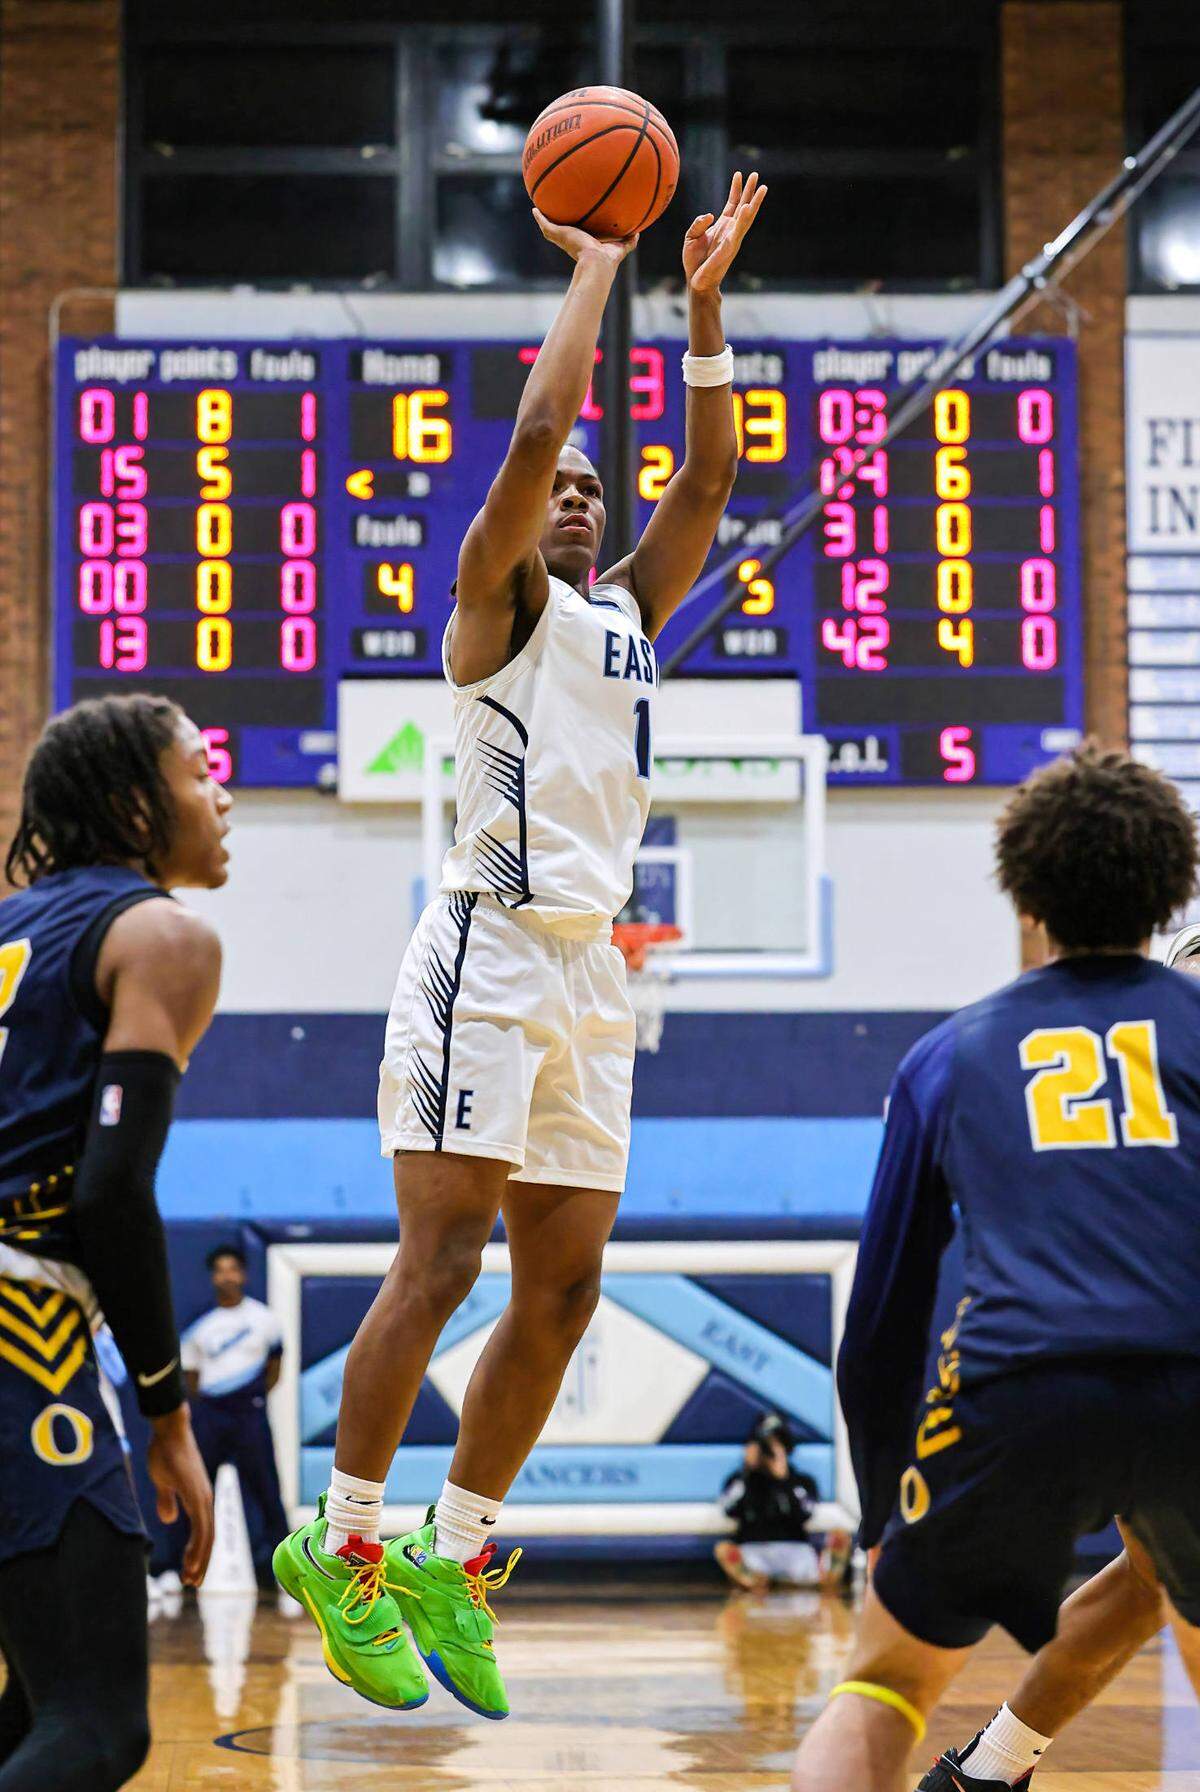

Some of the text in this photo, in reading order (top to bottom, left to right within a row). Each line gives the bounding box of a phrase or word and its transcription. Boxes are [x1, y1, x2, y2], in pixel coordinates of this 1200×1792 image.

[79, 388, 316, 443] 01 8 1
[393, 389, 452, 463] 16
[819, 388, 1053, 443] 03 0 0
[1147, 419, 1200, 466] FI
[100, 446, 316, 500] 15 5 1
[638, 445, 674, 500] 2
[935, 446, 971, 500] 6
[1039, 448, 1054, 498] 1
[80, 502, 316, 557] 03 0 0
[824, 502, 1055, 557] 31 0 1
[79, 559, 316, 614] 00 0 0
[378, 563, 413, 613] 4
[738, 559, 774, 615] 5
[842, 558, 1056, 613] 12 0 0
[100, 616, 316, 672] 13 0 0
[603, 629, 659, 688] EAS
[822, 615, 1057, 671] 42 4 0
[200, 728, 232, 784] 5
[633, 698, 650, 779] 1
[940, 726, 975, 782] 5
[455, 1090, 474, 1130] E
[1018, 1019, 1179, 1152] 21
[31, 1403, 94, 1467] O
[520, 1462, 640, 1487] ANCERS
